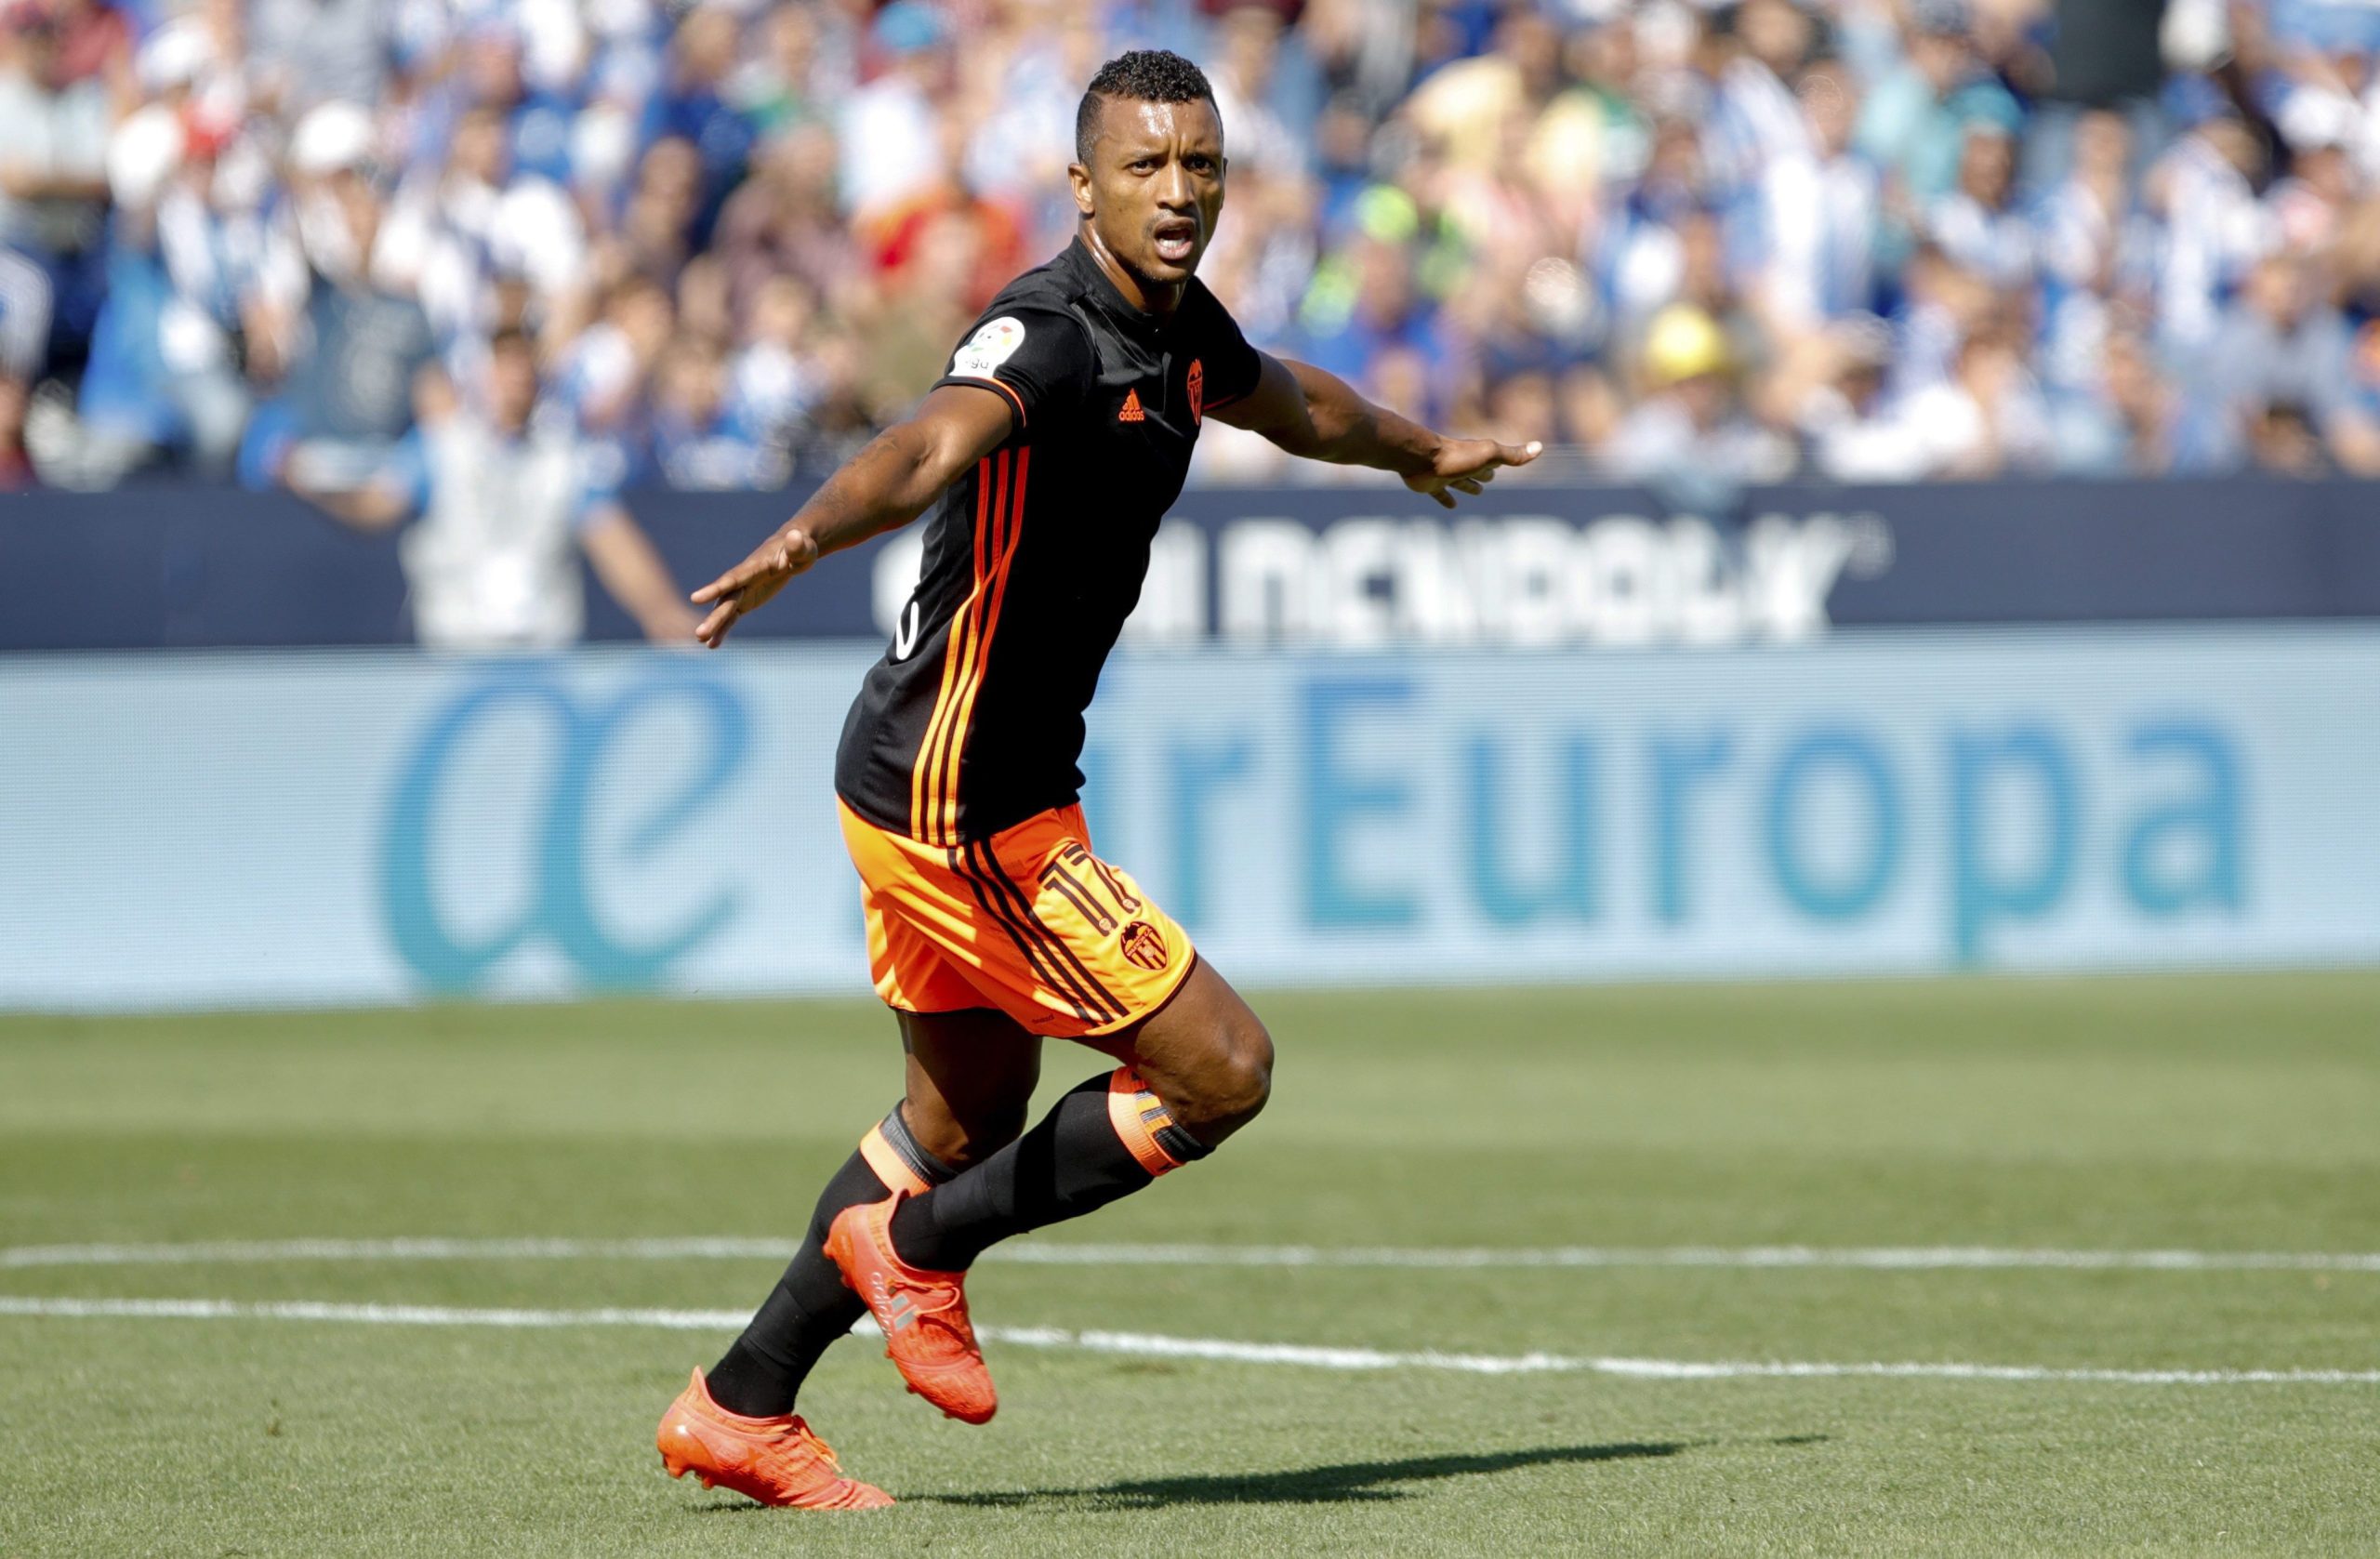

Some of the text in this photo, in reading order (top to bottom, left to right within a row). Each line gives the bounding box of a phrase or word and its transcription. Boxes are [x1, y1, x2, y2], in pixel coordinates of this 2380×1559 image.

[1118, 409, 1144, 421] adidas
[1080, 669, 2248, 969] irEuropa
[1037, 843, 1141, 936] 17
